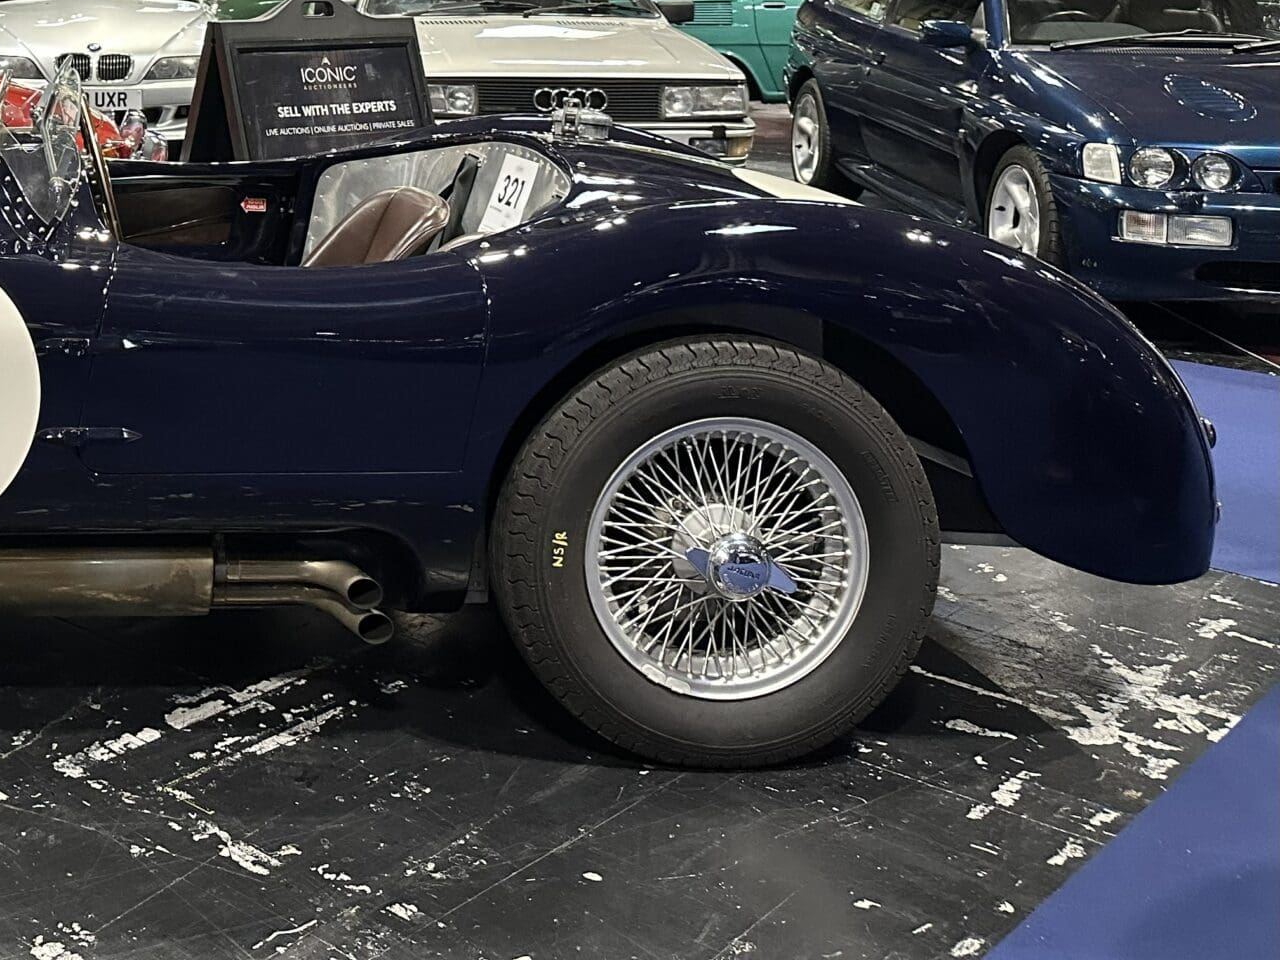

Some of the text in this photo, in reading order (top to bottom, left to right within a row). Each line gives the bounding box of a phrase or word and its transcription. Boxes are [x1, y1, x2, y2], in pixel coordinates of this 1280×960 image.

[300, 65, 357, 83] ICONIC
[303, 82, 358, 91] AUCTIONEERS
[94, 91, 128, 108] UXR
[277, 100, 397, 118] SELL WITH THE EXPERTS
[265, 120, 415, 136] LIVE AUCTIONS ONLINE AUCTIONS PRIVATE SALES
[497, 174, 526, 209] 321
[552, 531, 568, 567] NS/R
